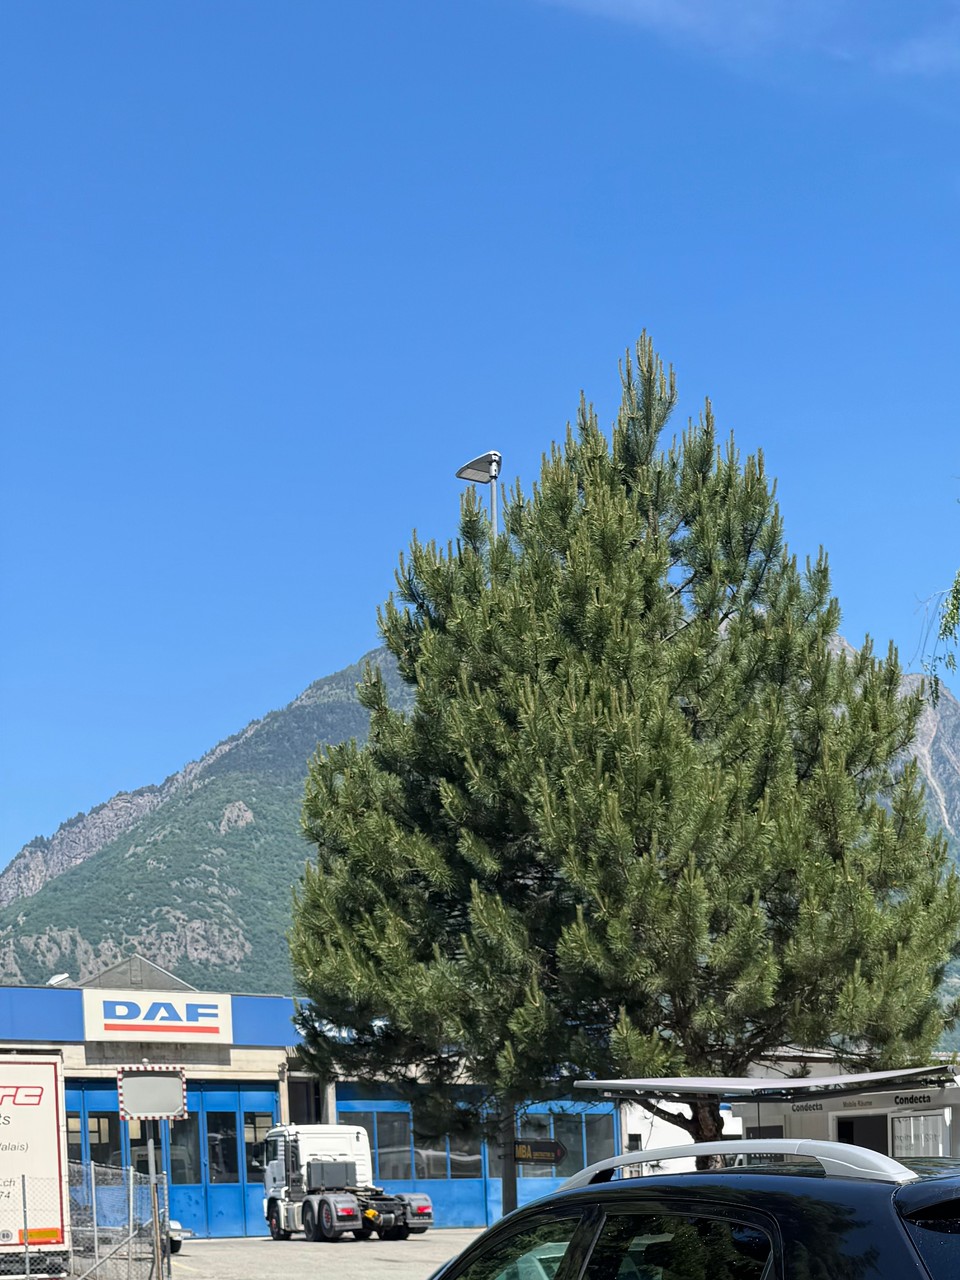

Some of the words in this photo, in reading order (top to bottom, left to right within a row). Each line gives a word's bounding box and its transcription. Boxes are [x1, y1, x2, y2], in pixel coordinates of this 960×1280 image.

[102, 1000, 219, 1022] DAF
[894, 1094, 932, 1105] Condecta
[791, 1102, 823, 1113] Condecta
